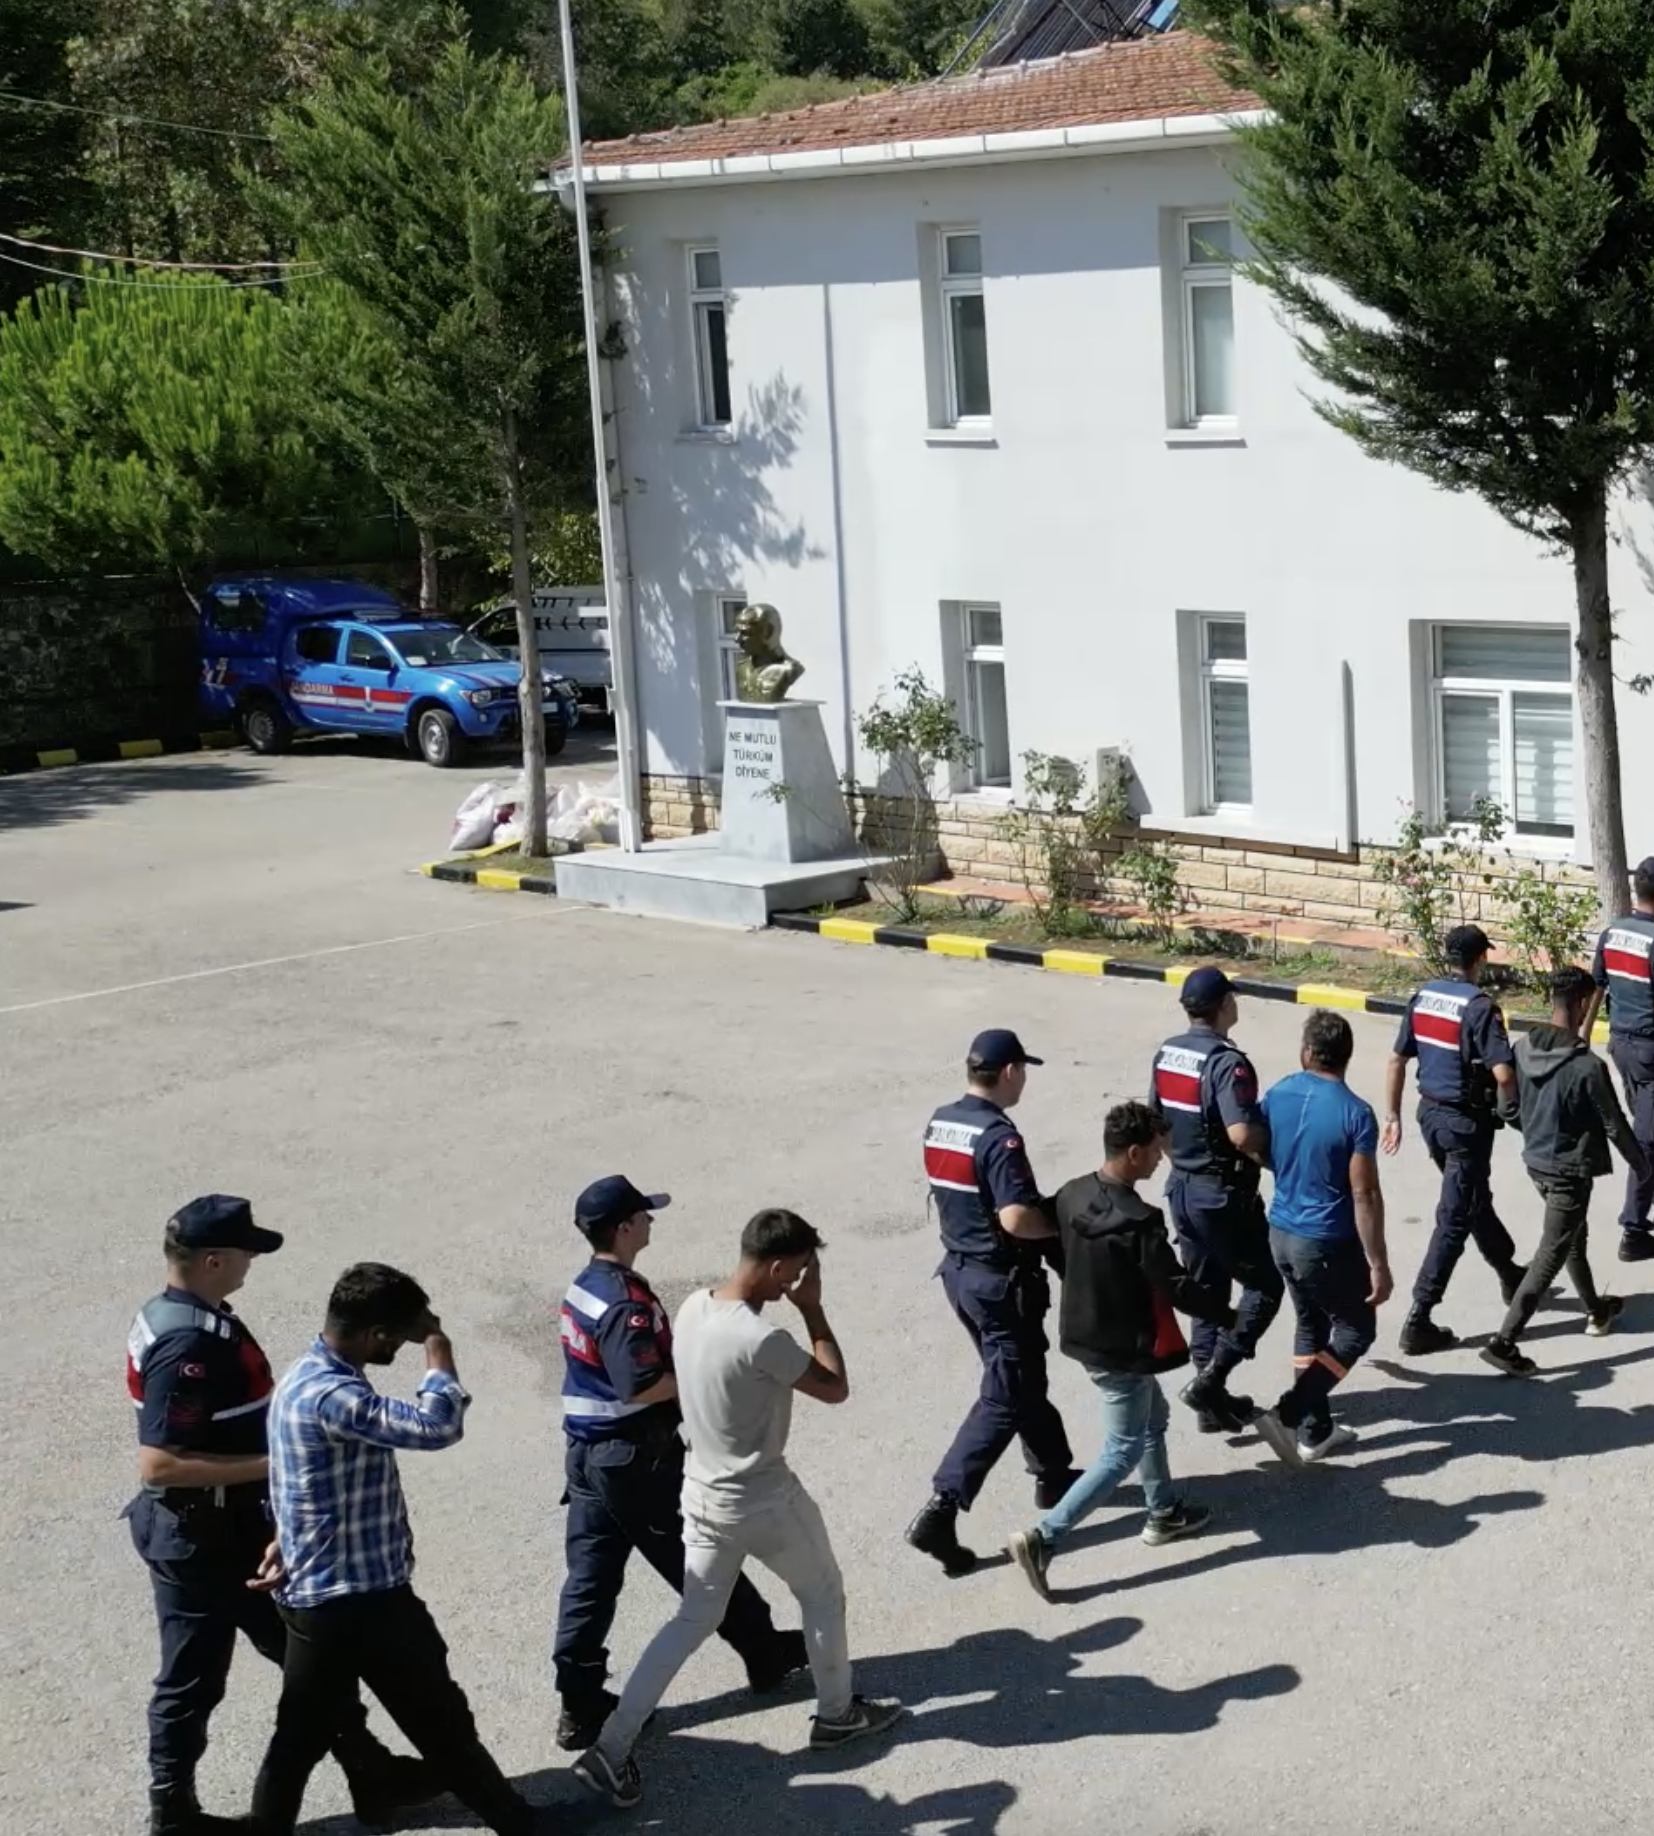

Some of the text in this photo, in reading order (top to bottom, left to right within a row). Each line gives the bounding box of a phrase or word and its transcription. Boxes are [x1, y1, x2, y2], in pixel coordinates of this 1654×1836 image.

[728, 731, 777, 745] NE MUTLU
[733, 747, 773, 762] TÜRKÜM
[735, 764, 770, 780] DİYENE
